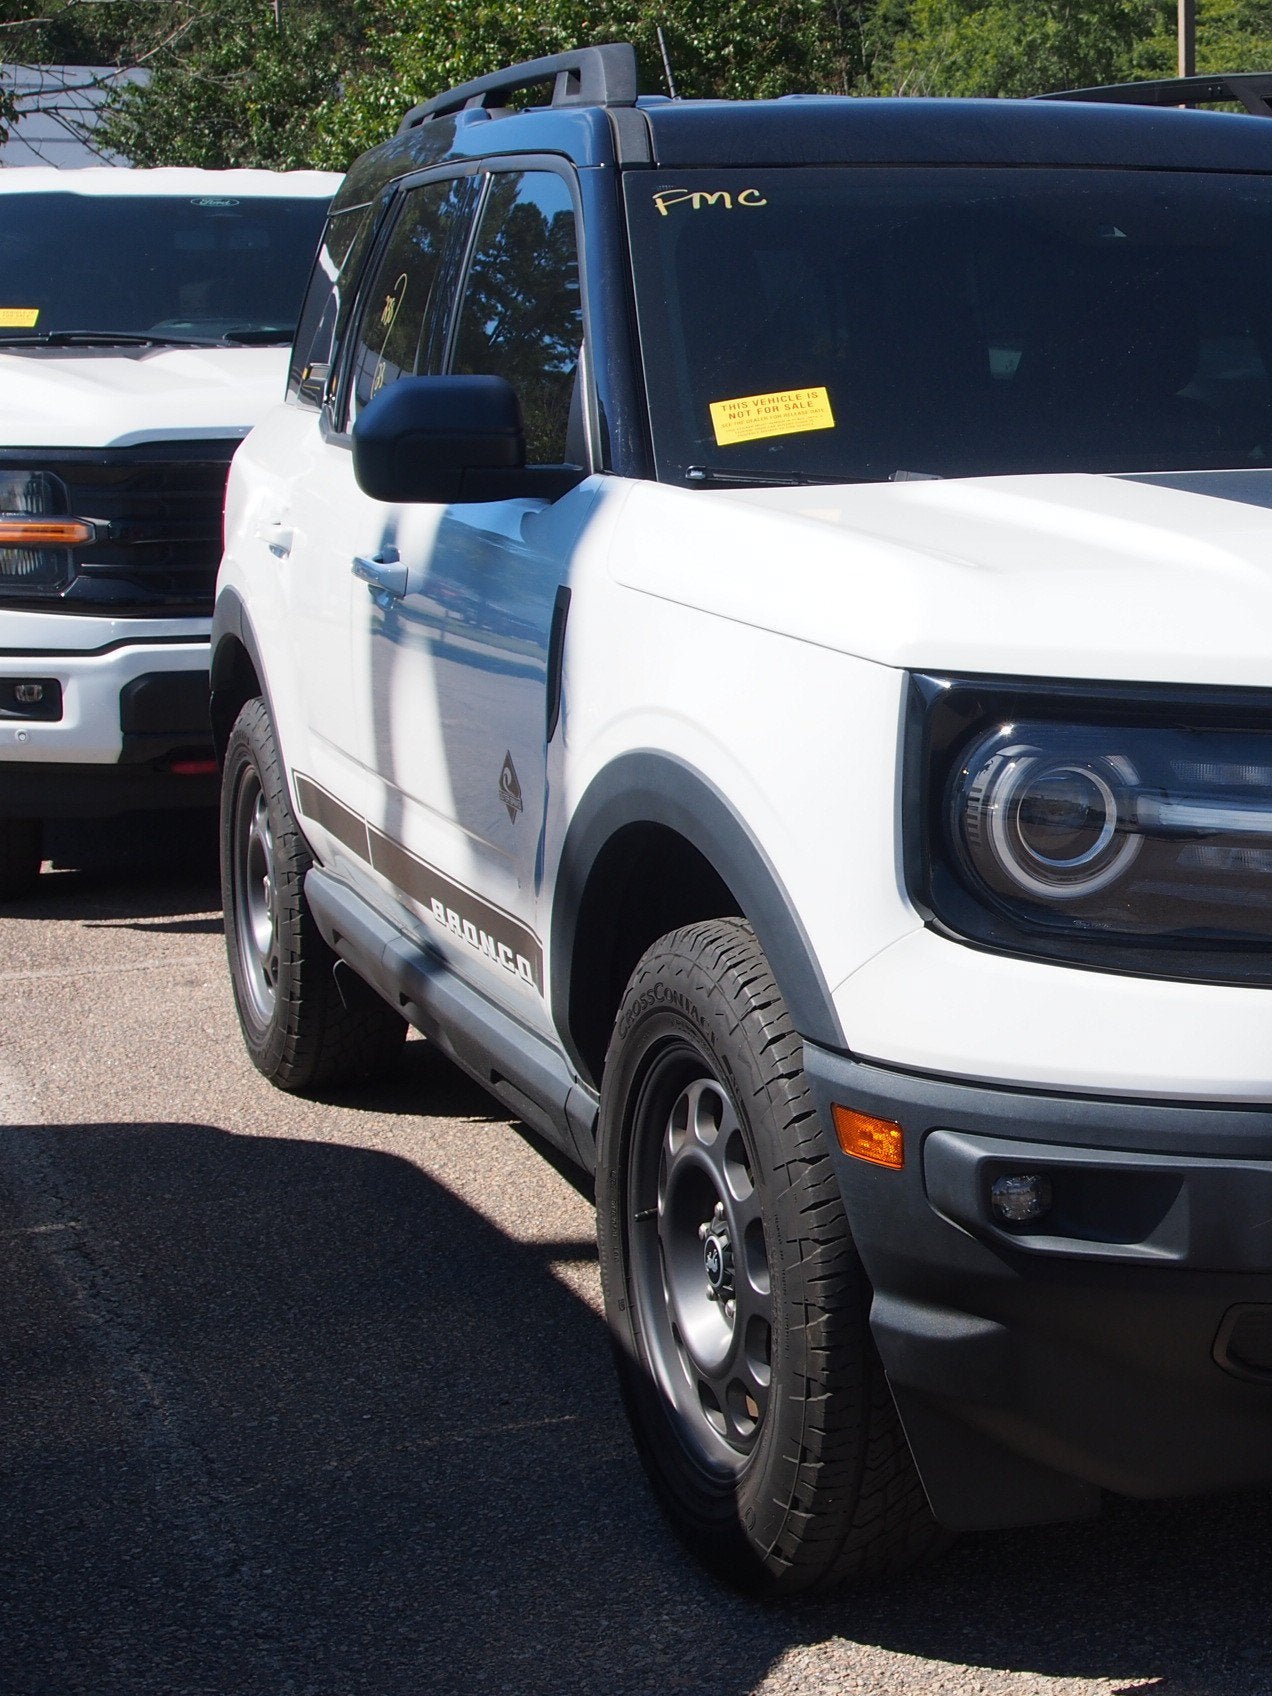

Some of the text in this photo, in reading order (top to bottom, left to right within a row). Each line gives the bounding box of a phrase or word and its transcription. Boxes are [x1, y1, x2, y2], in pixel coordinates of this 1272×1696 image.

[652, 188, 768, 216] FMC
[721, 391, 819, 413] THIS VEHICLE IS
[728, 400, 814, 420] NOT FOR SALE
[430, 896, 534, 988] BRONCO
